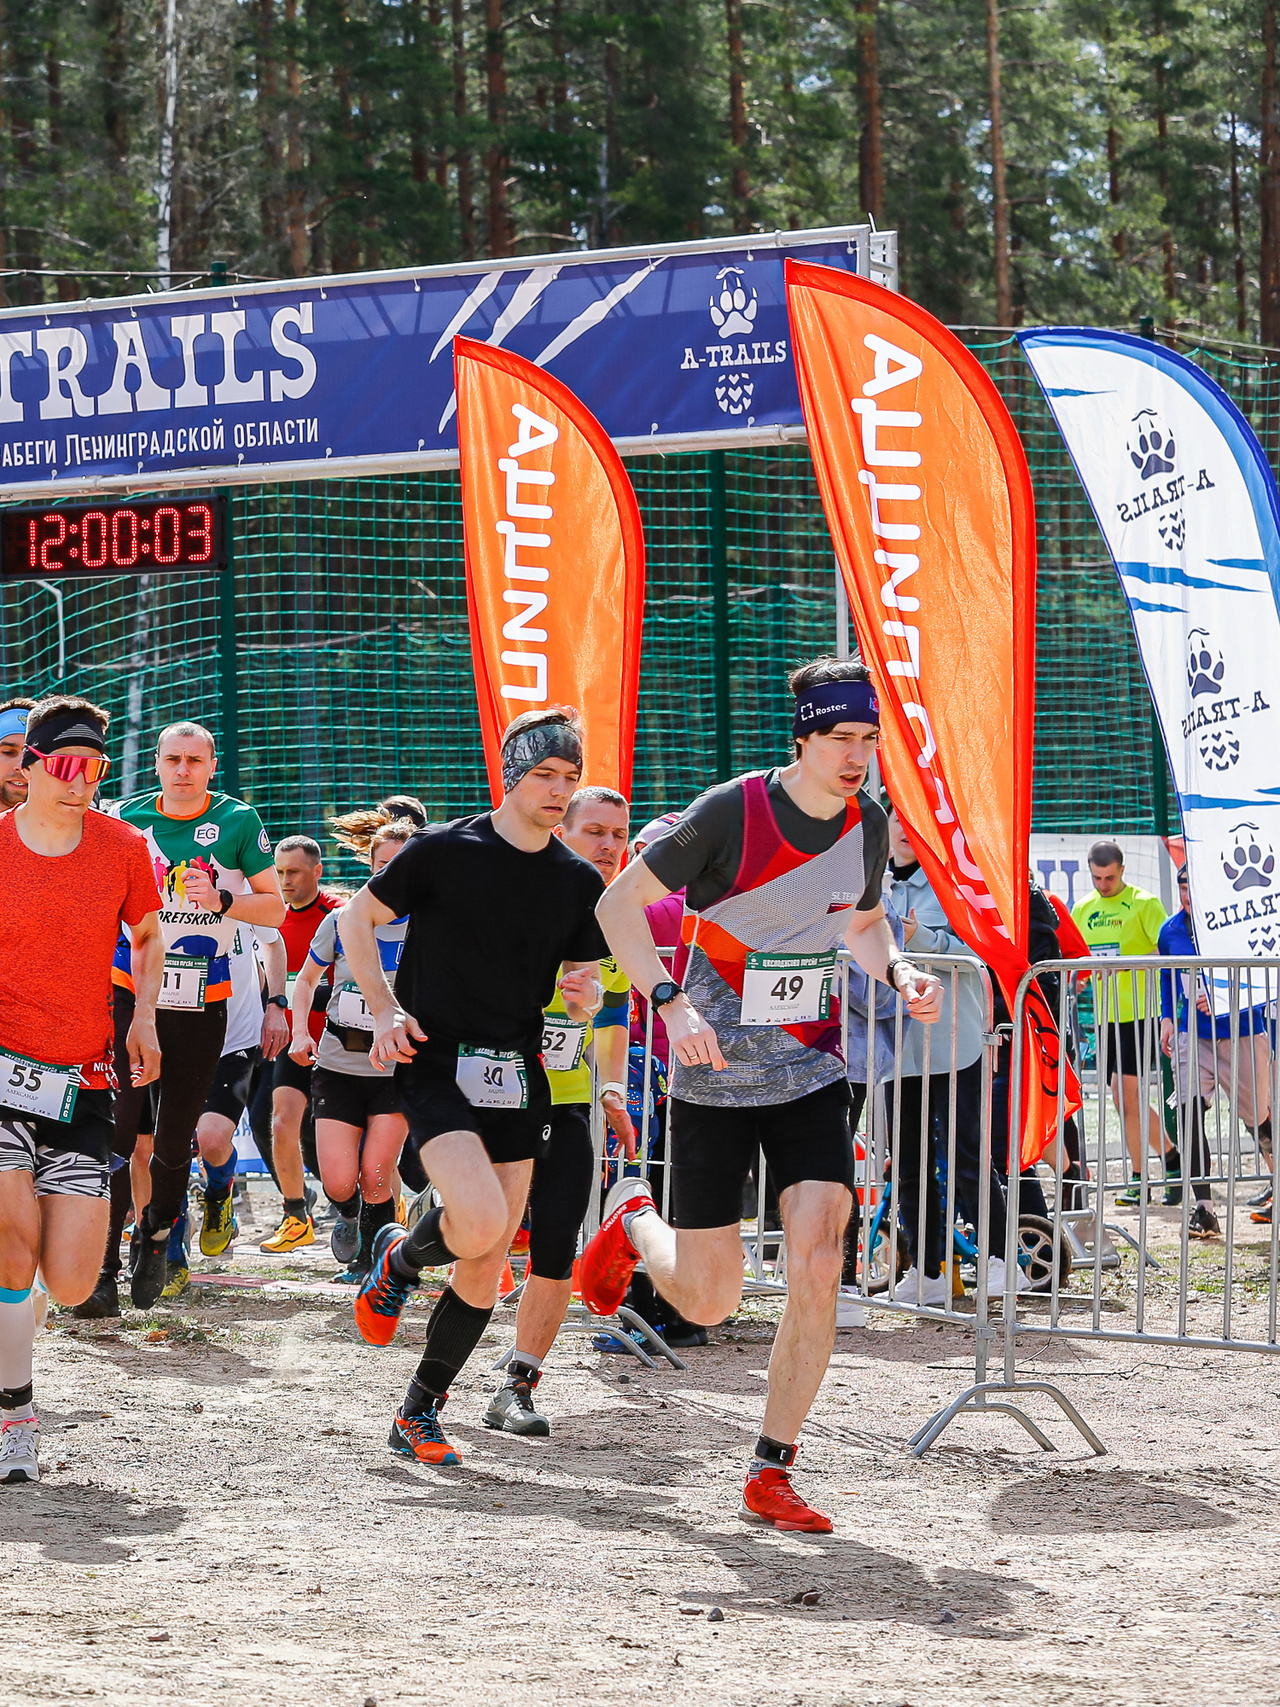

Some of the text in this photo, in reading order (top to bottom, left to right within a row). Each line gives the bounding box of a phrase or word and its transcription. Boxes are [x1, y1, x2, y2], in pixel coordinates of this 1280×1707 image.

[680, 340, 787, 370] A-TRAILS
[233, 417, 319, 449] ОБЛАСТИ
[29, 505, 211, 569] 12:00:03
[815, 703, 848, 716] Rostec
[197, 827, 216, 839] EG
[162, 972, 181, 989] 11
[771, 975, 804, 1001] 49
[820, 981, 828, 1014] LONG
[541, 1030, 567, 1051] 52
[8, 1064, 43, 1092] 55
[62, 1088, 73, 1118] LONG
